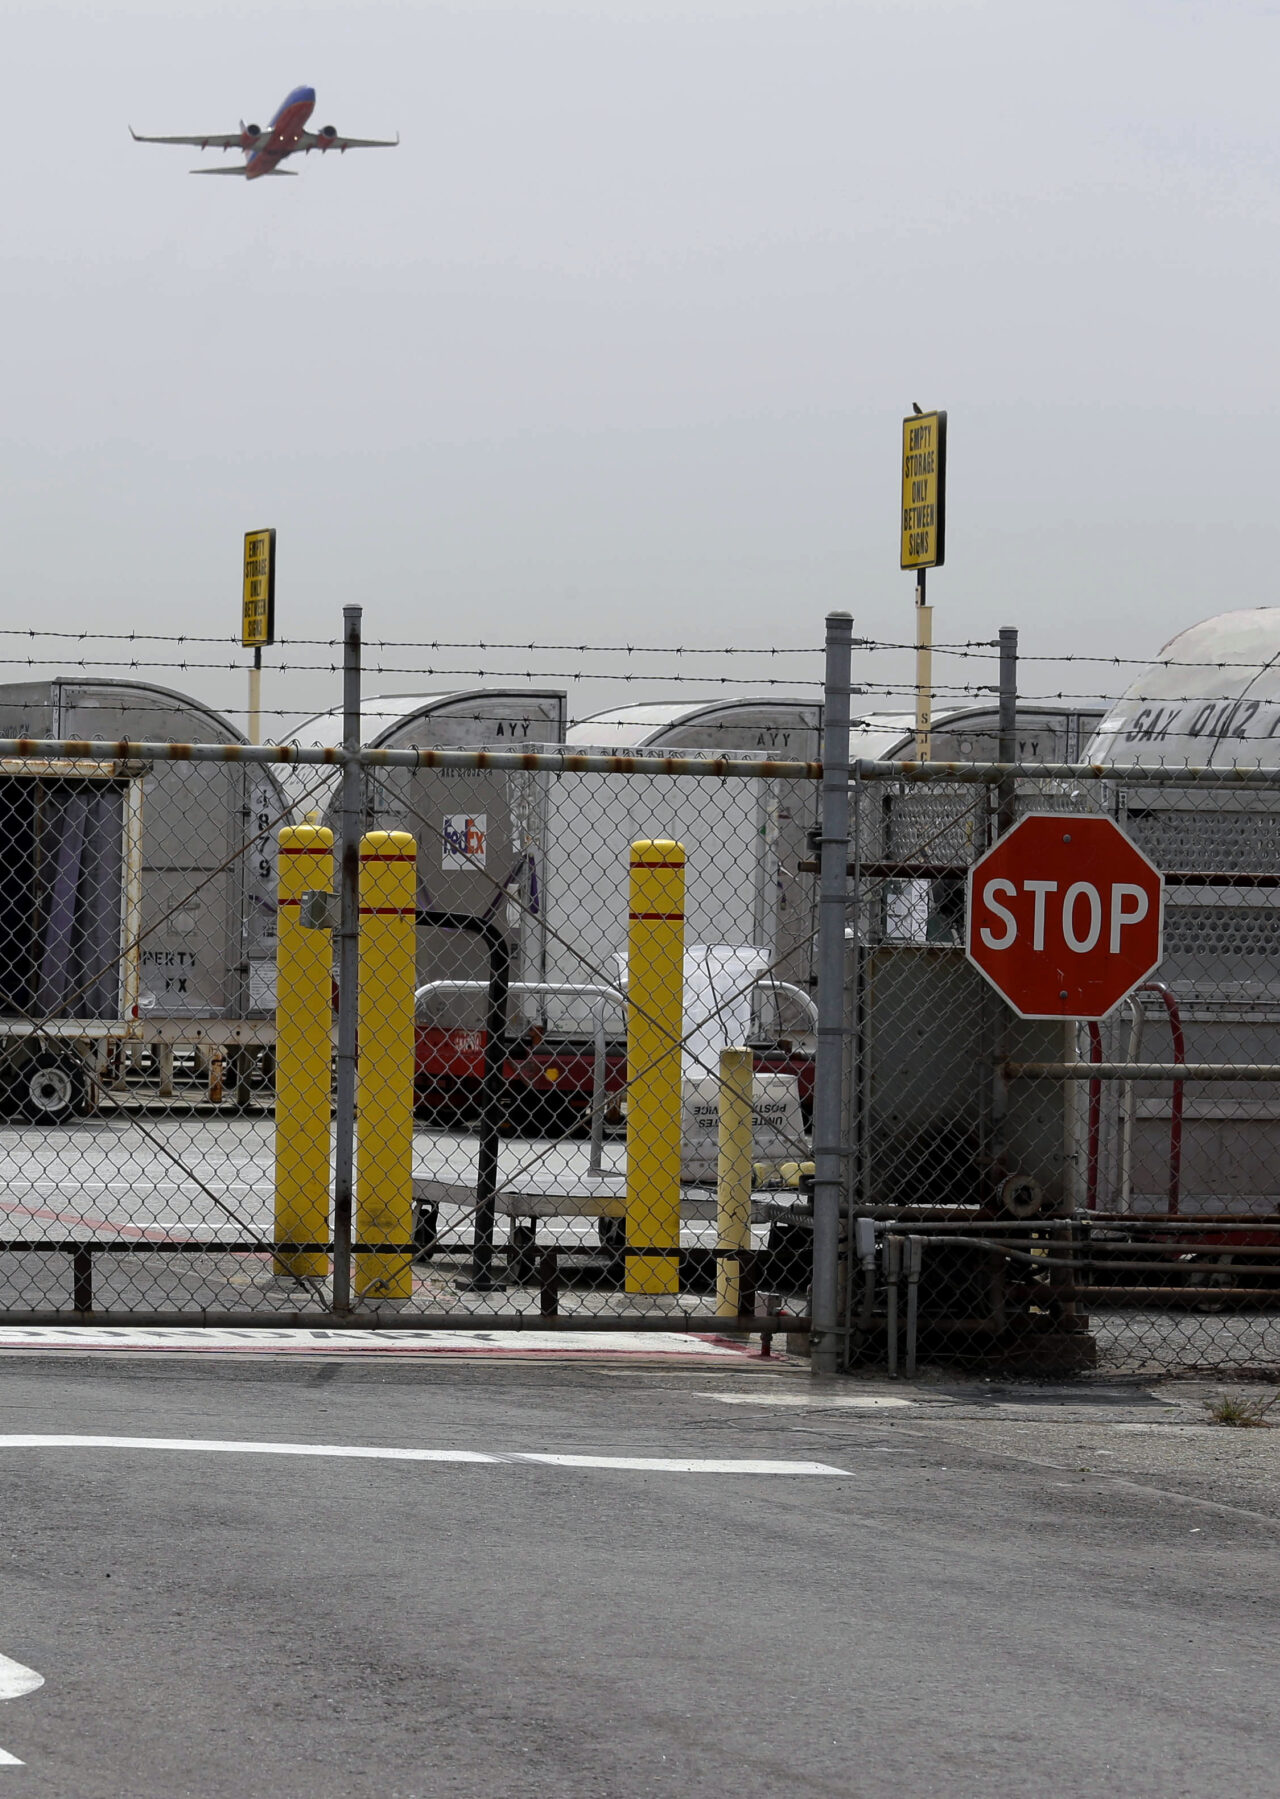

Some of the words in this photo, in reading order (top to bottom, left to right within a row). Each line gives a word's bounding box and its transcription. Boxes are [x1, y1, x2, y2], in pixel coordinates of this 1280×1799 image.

[910, 425, 931, 451] EMPTY
[905, 451, 934, 479] STORAGE
[912, 479, 928, 504] ONLY
[904, 504, 934, 532] BETWEEN
[909, 531, 929, 557] SIGNS
[496, 722, 530, 737] AYY
[757, 733, 791, 747] AYY
[444, 819, 486, 854] FedEx
[980, 878, 1149, 954] STOP
[140, 952, 197, 966] PERTY
